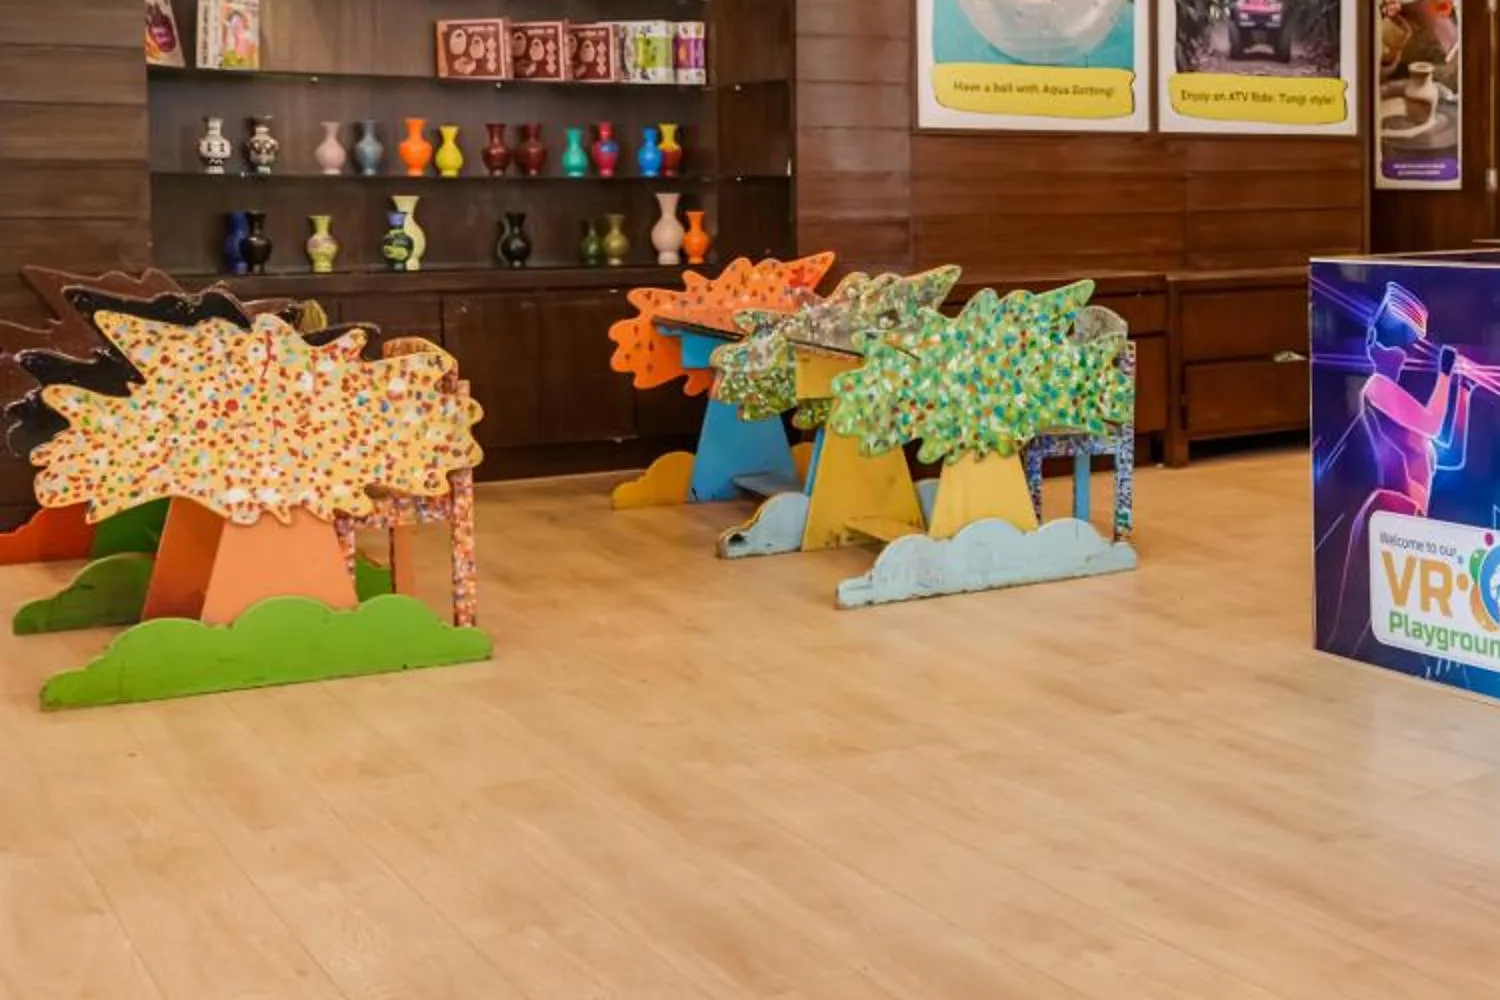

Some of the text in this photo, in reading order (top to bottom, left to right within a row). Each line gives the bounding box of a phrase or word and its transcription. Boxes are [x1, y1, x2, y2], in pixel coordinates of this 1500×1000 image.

[953, 79, 981, 93] Have
[1016, 83, 1039, 94] with
[1042, 84, 1069, 97] Aqua
[1181, 89, 1210, 104] Enjoy
[1213, 92, 1225, 102] an
[1228, 91, 1248, 103] ATV
[1379, 530, 1457, 557] Welcome to our
[1382, 550, 1454, 619] VR
